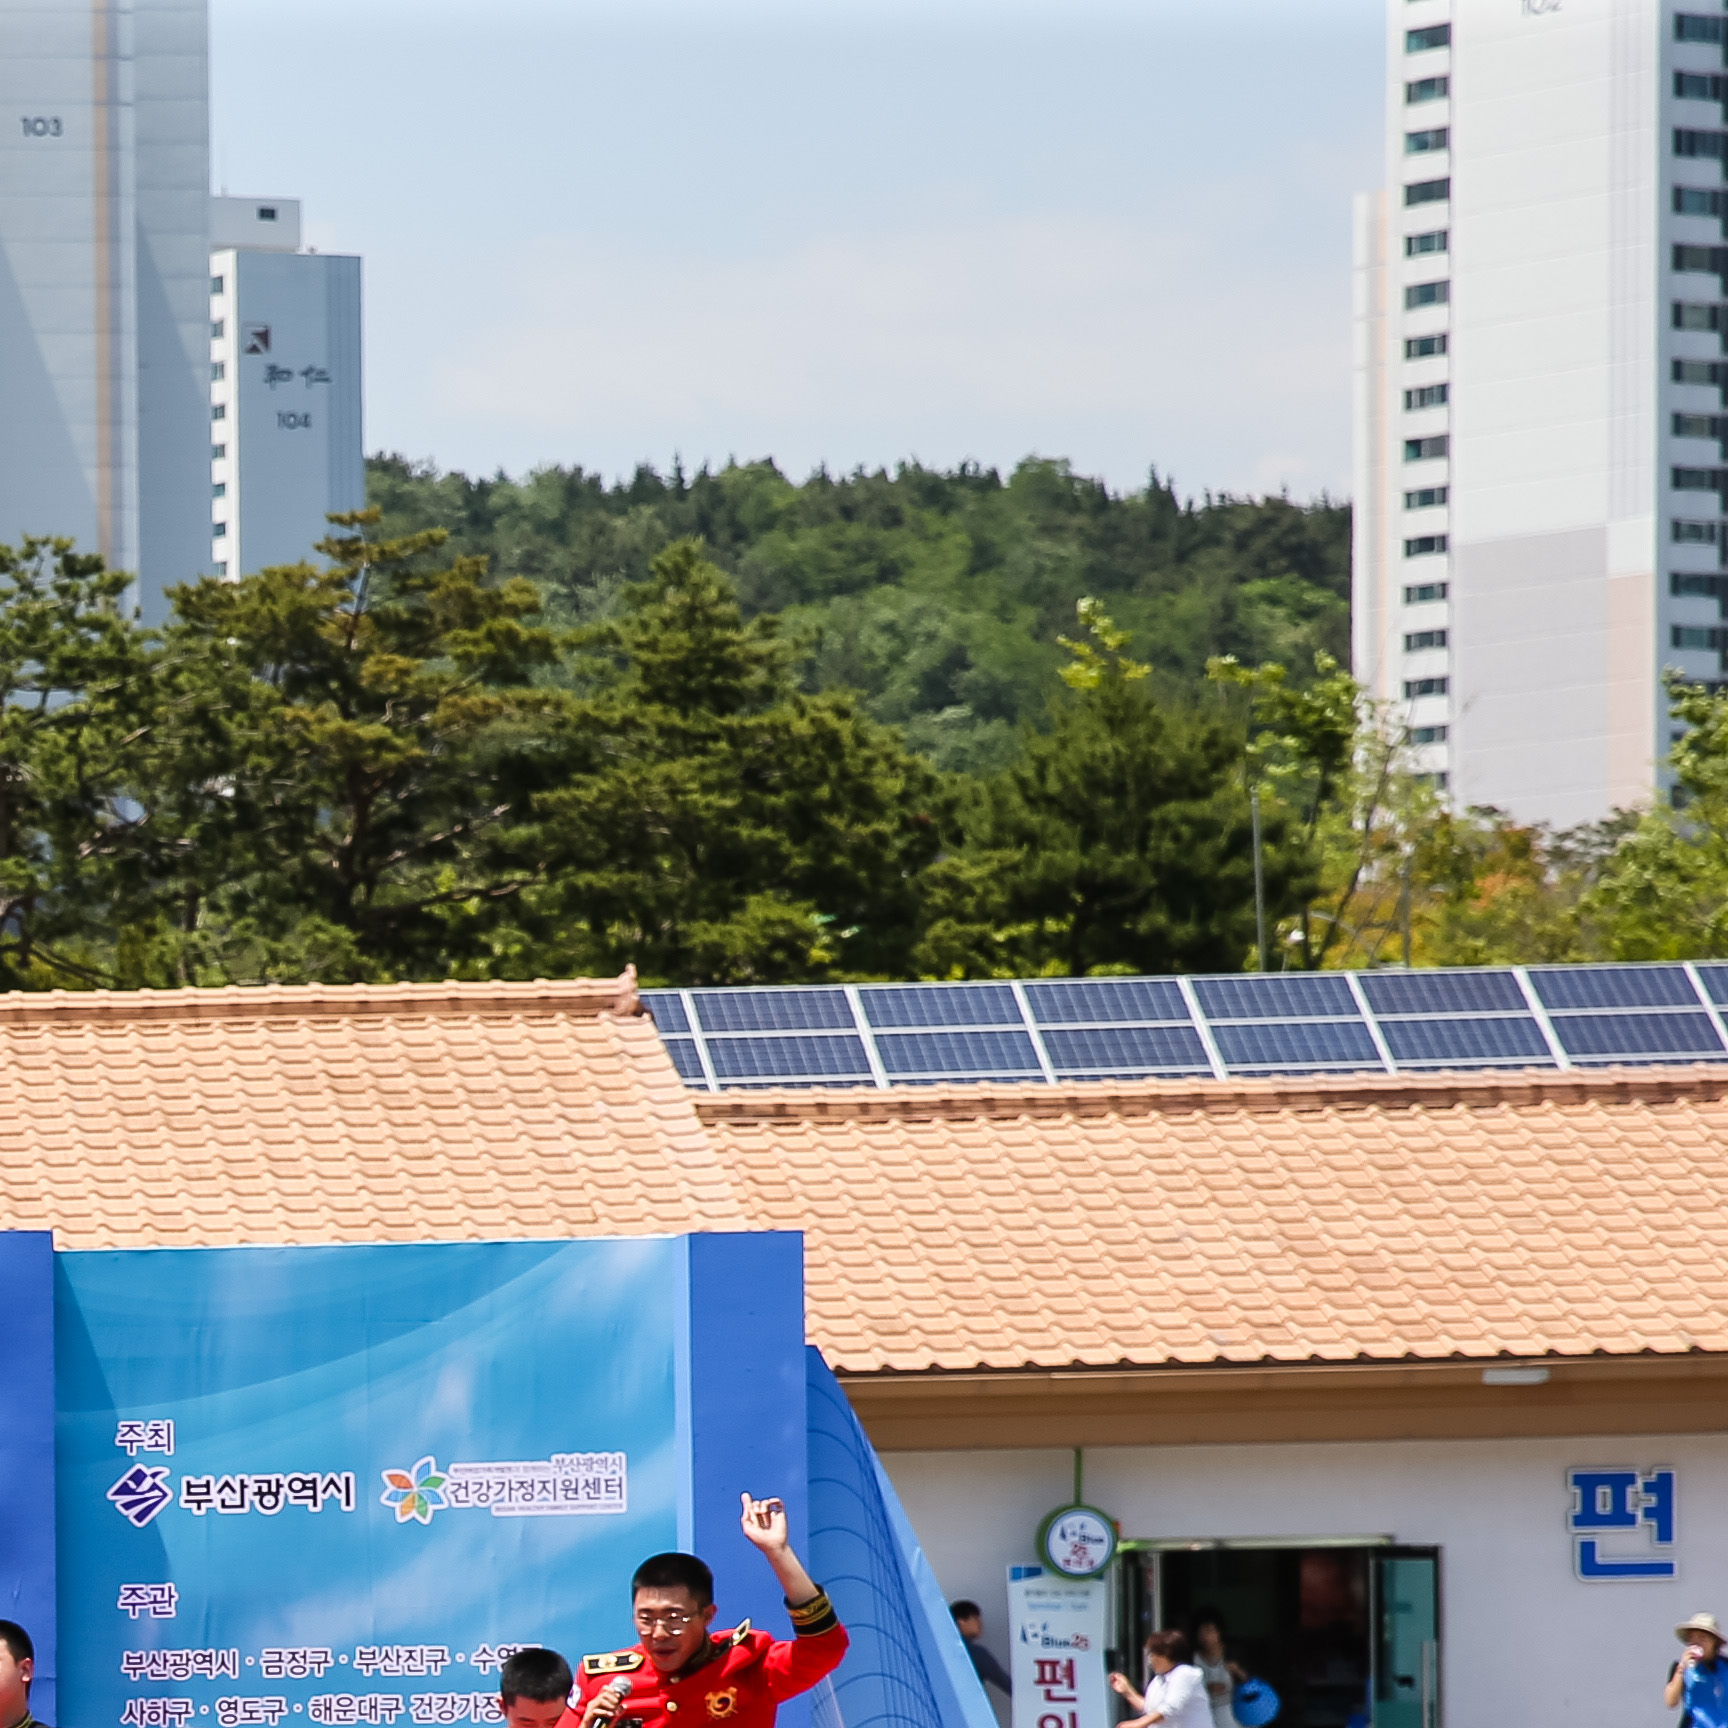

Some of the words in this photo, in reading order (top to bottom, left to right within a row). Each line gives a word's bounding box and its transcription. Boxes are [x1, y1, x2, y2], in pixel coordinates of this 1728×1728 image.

[20, 115, 64, 138] 103
[117, 1421, 172, 1454] 주최
[183, 1475, 351, 1511] 부산광역시
[449, 1475, 624, 1504] 건강가정지원센터
[1569, 1466, 1677, 1581] 편
[120, 1586, 176, 1616] 주관
[123, 1650, 237, 1678] 부산광역시
[262, 1649, 331, 1676] 금정구
[357, 1647, 448, 1675] 부산진구
[122, 1699, 193, 1726] 사하구
[217, 1698, 287, 1724] 영도구
[310, 1696, 403, 1721] 해운대구
[411, 1694, 503, 1720] 건강가정
